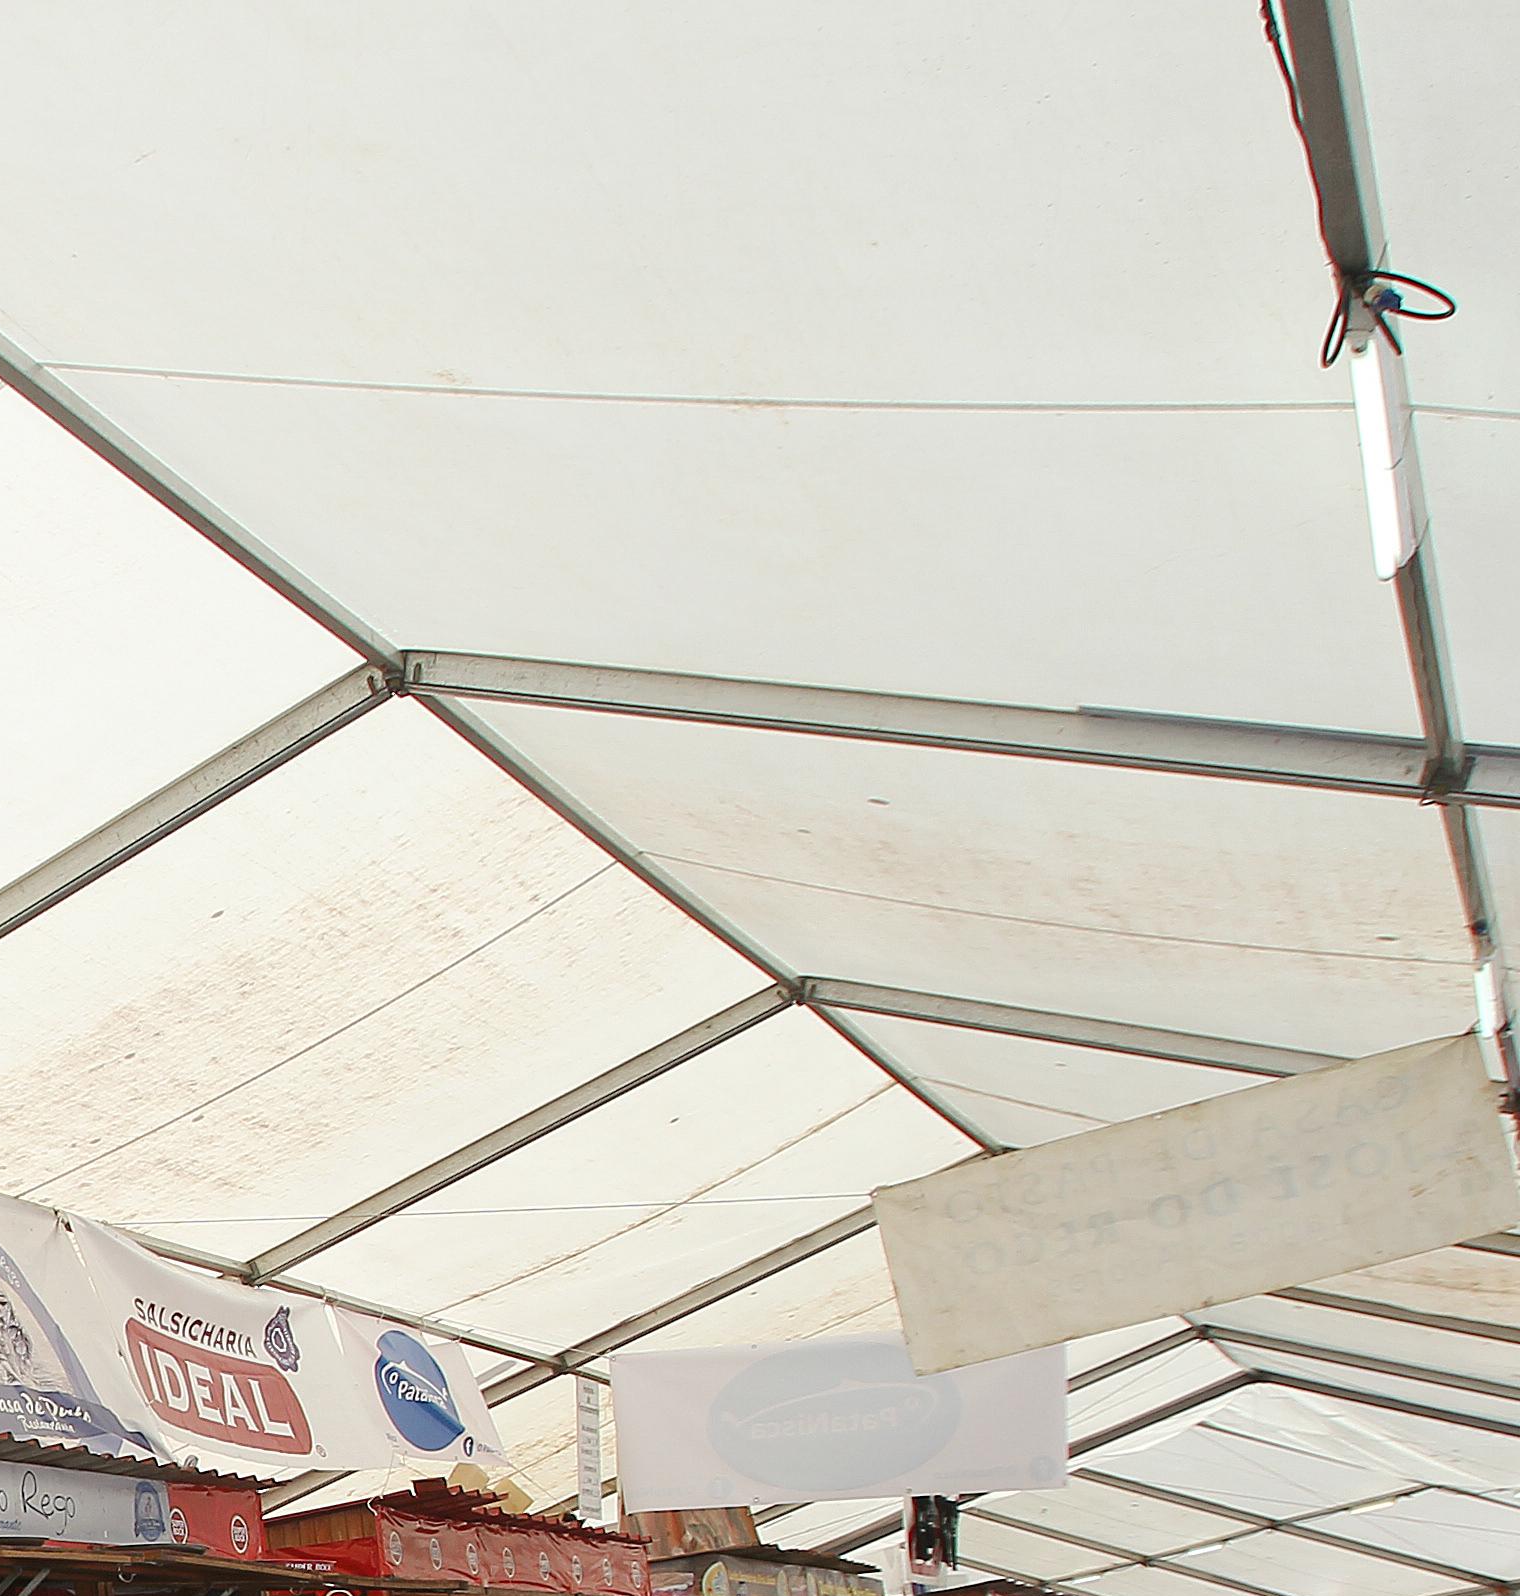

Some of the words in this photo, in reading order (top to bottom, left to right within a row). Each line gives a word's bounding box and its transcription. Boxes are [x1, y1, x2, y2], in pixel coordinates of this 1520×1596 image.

[134, 1297, 258, 1359] SALSICHARIA
[136, 1340, 297, 1441] IDEAL
[20, 1470, 77, 1536] Rego
